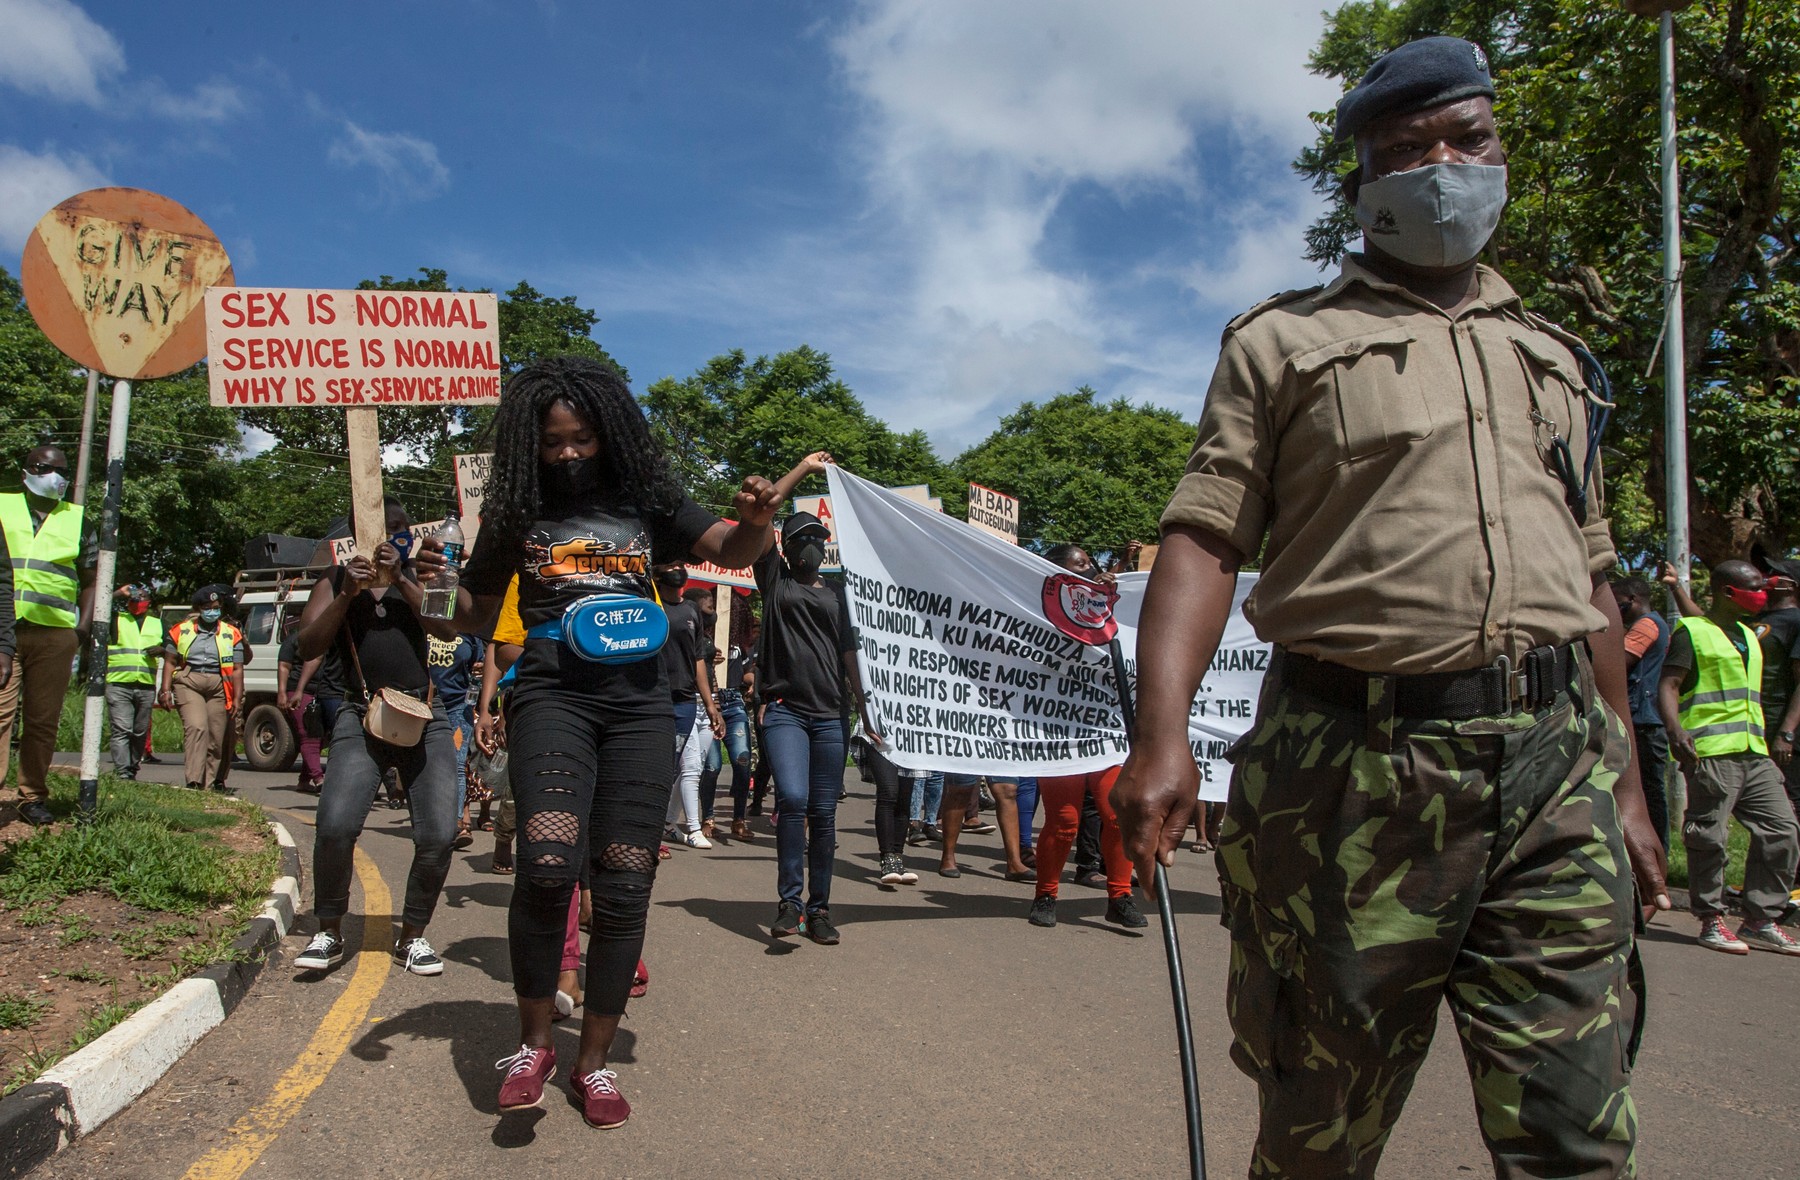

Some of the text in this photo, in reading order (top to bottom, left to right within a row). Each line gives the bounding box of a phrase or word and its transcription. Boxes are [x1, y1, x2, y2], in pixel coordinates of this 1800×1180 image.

[77, 224, 192, 279] GIVE
[83, 273, 181, 325] WAY
[221, 292, 487, 329] SEX IS NORMAL
[222, 338, 500, 371] SERVICE IS NORMAL
[223, 376, 287, 404] WHY
[295, 377, 316, 403] IS
[325, 376, 445, 404] SEX-SERVICE
[459, 457, 468, 469] A
[969, 485, 1013, 519] MA BAR
[886, 584, 952, 619] CORONA
[958, 600, 1088, 666] WATIKHUDZA.
[942, 623, 969, 646] KU
[971, 630, 1062, 671] MAROOM
[908, 647, 992, 681] RESPONSE
[995, 664, 1051, 692] MUST
[894, 672, 947, 702] RIGHTS
[953, 682, 971, 705] OF
[1023, 693, 1122, 728] WORKERS
[1216, 700, 1252, 718] THE
[906, 704, 933, 727] SEX
[935, 708, 1007, 739] WORKERS
[895, 727, 973, 758] CHITETEZO
[974, 739, 1072, 762] CHOFANANA
